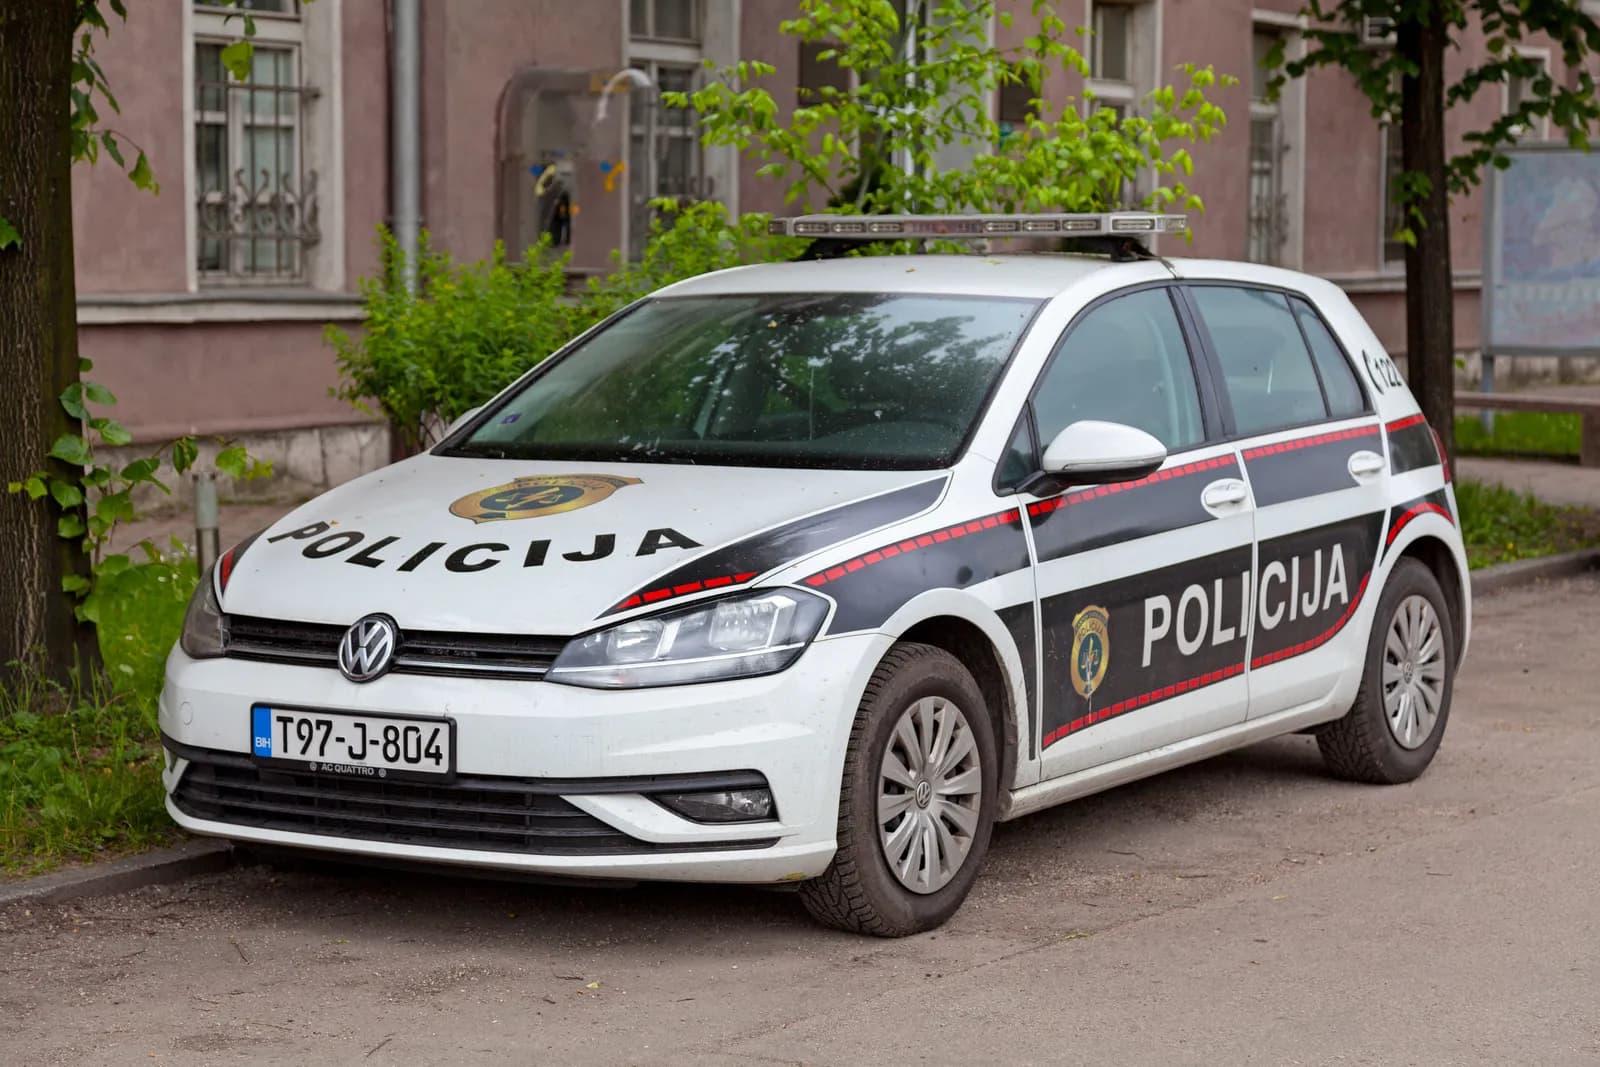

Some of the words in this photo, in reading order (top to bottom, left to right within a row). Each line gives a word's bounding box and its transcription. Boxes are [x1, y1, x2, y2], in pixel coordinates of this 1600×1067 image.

[268, 520, 704, 573] POLICIJA
[1142, 543, 1349, 668] POLICIJA
[255, 736, 271, 749] BIH
[276, 715, 443, 766] T97-J-804
[321, 763, 334, 772] AC
[334, 764, 375, 776] QUATTRO
